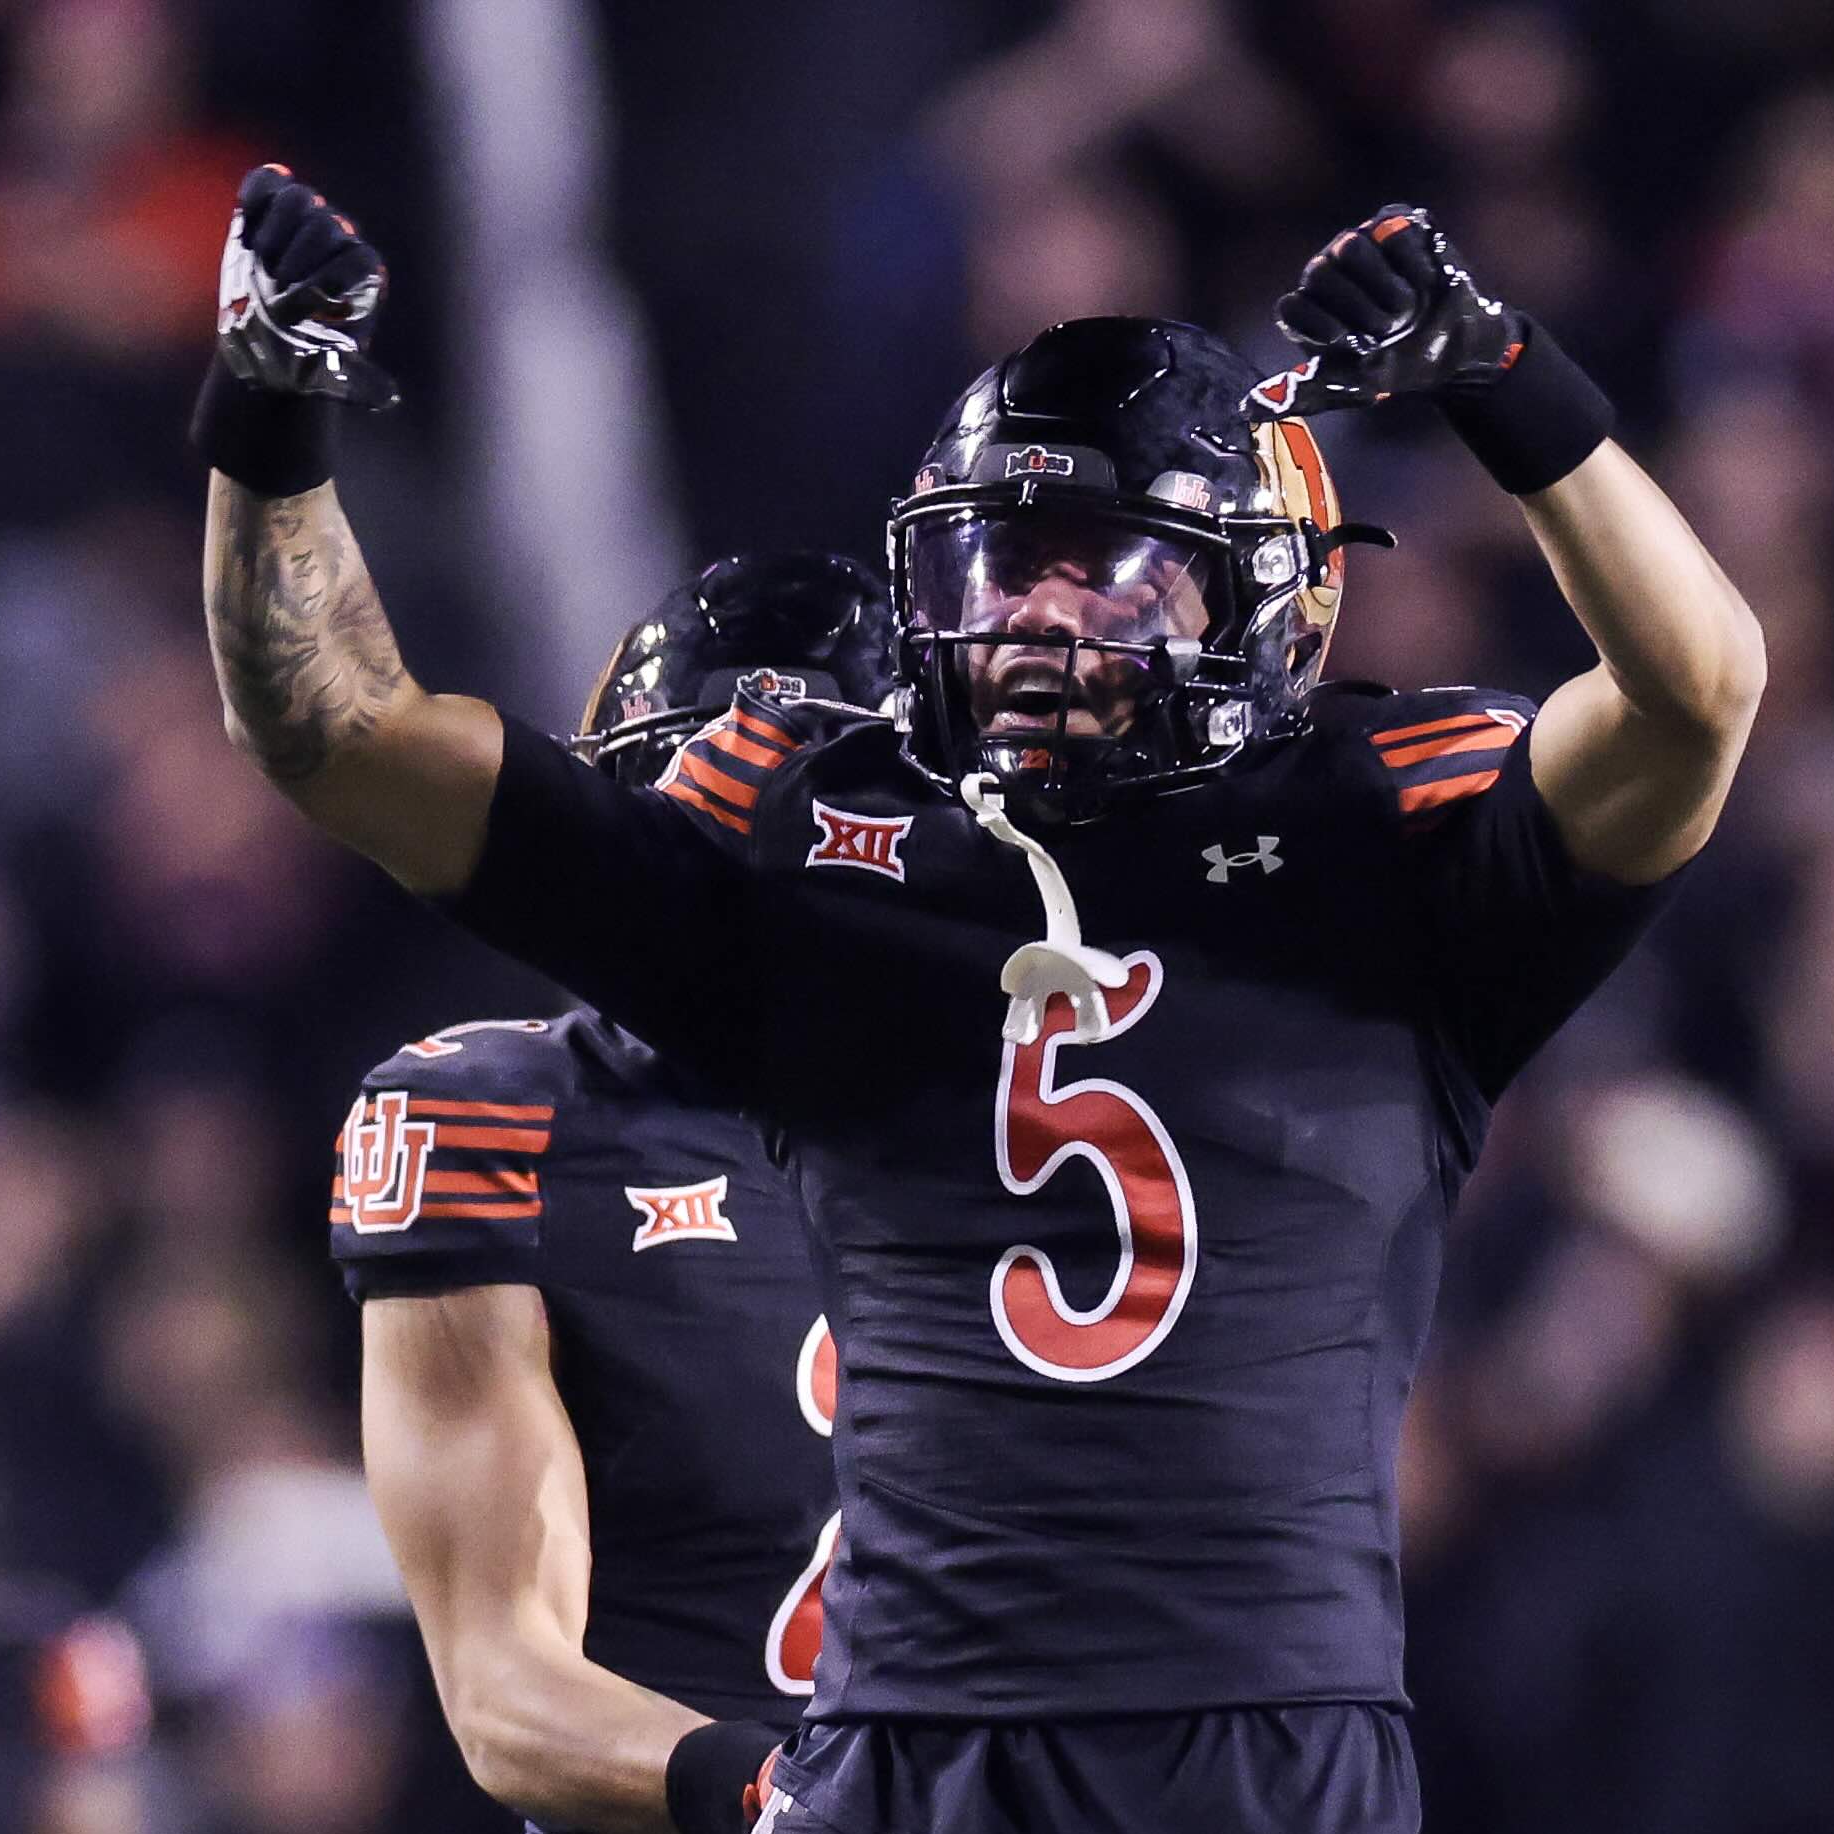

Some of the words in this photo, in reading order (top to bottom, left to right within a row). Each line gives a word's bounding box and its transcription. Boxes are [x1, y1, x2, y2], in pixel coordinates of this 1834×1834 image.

[810, 803, 910, 880] XII
[989, 949, 1198, 1383] 5
[627, 1177, 735, 1249] XII
